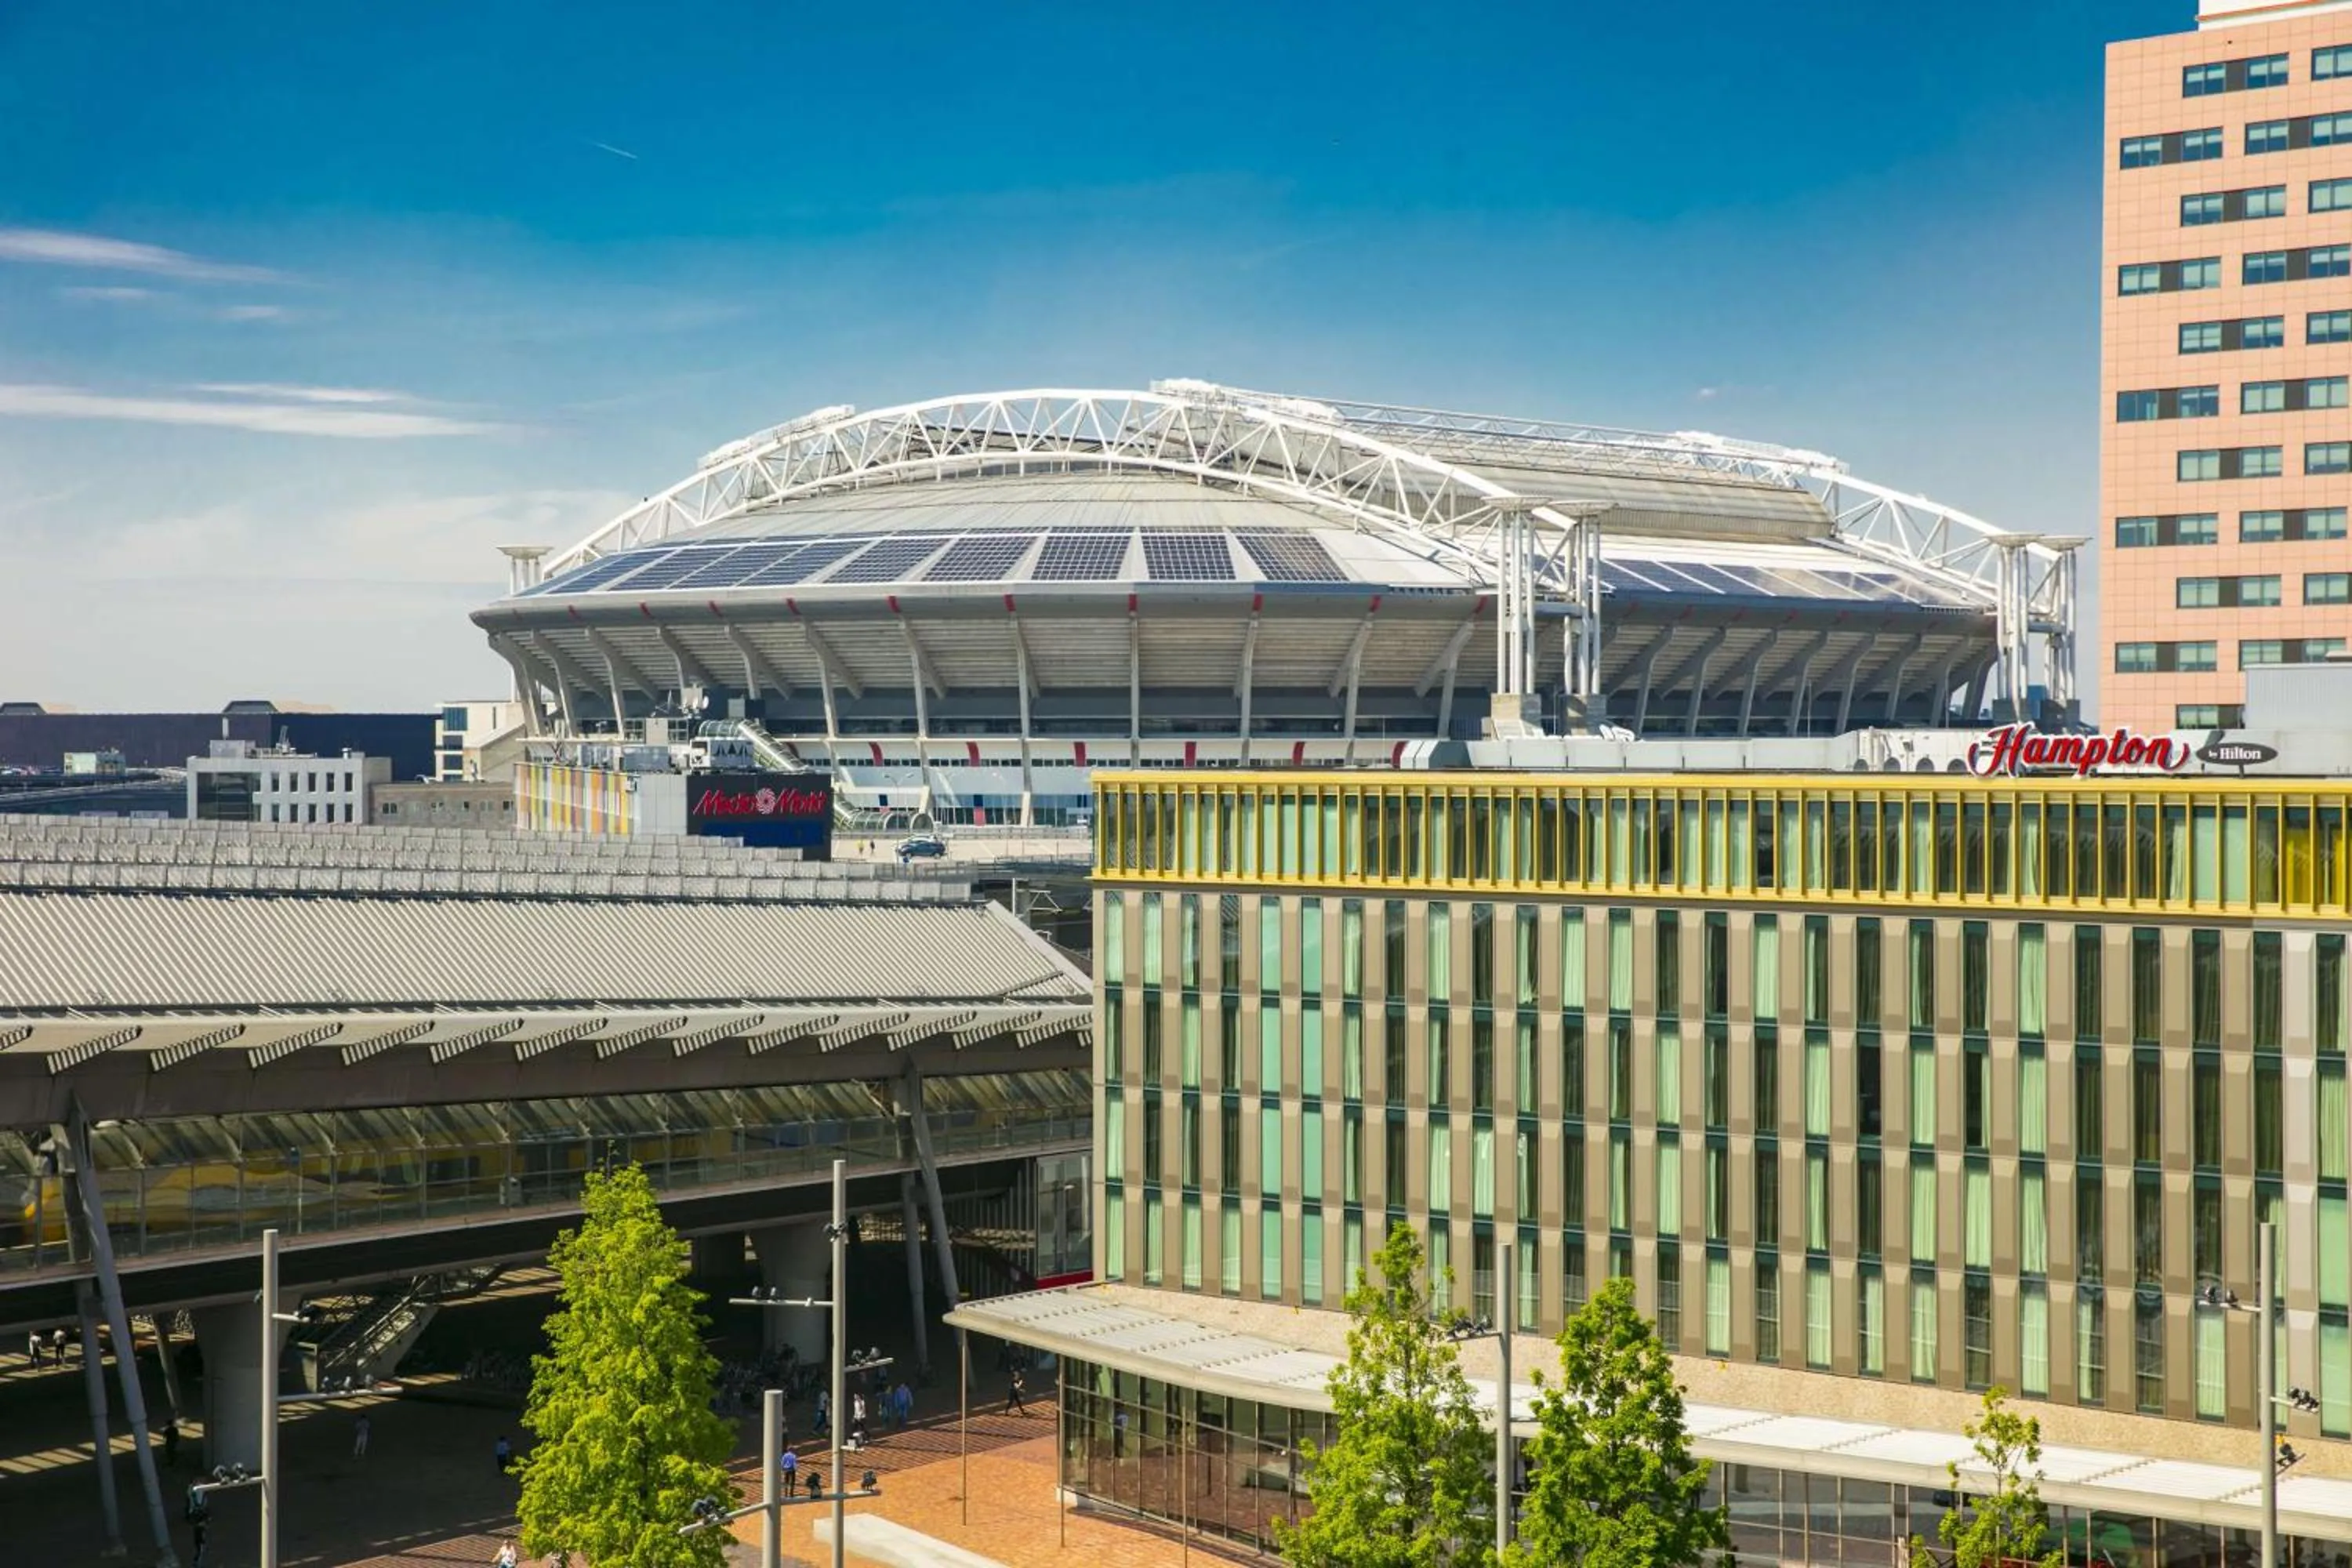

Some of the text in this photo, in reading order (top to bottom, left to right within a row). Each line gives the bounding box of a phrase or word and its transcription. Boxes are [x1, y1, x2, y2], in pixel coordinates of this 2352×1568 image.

[1967, 722, 2190, 778] Hampton
[2220, 746, 2262, 760] Hilton
[692, 787, 827, 815] Media Markt
